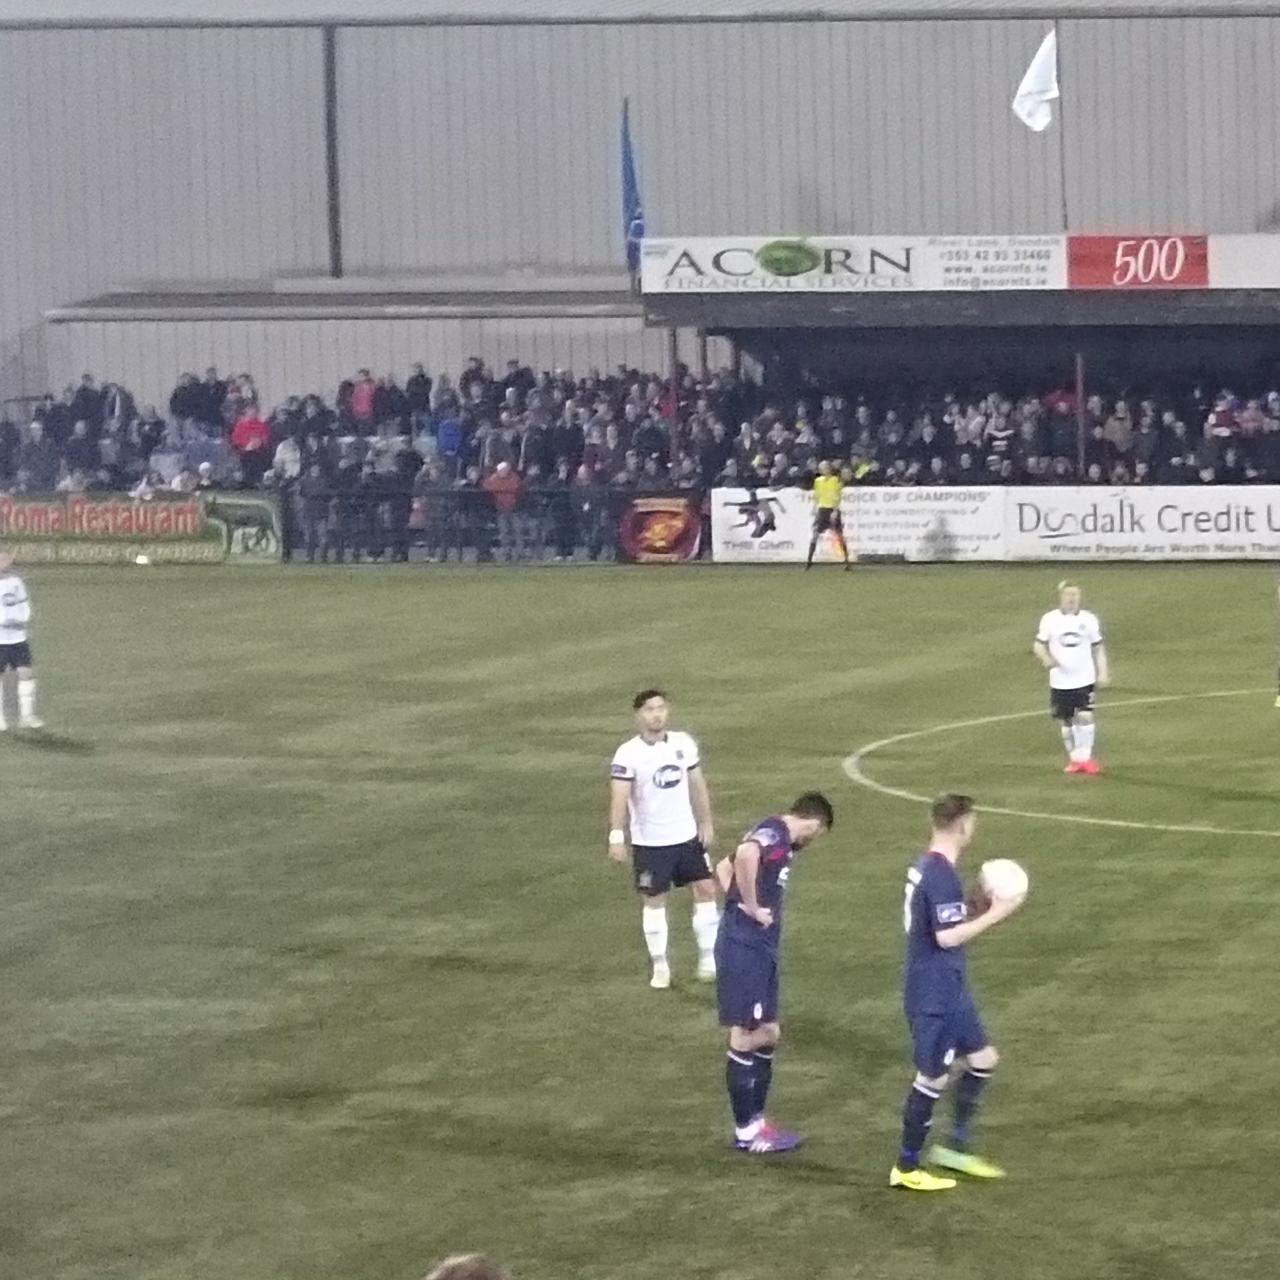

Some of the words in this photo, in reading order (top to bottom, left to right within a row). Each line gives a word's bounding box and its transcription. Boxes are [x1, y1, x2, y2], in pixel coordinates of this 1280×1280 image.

[668, 240, 914, 277] ACORN
[1112, 237, 1185, 286] 500
[883, 491, 901, 503] OF
[1156, 503, 1256, 533] Credit
